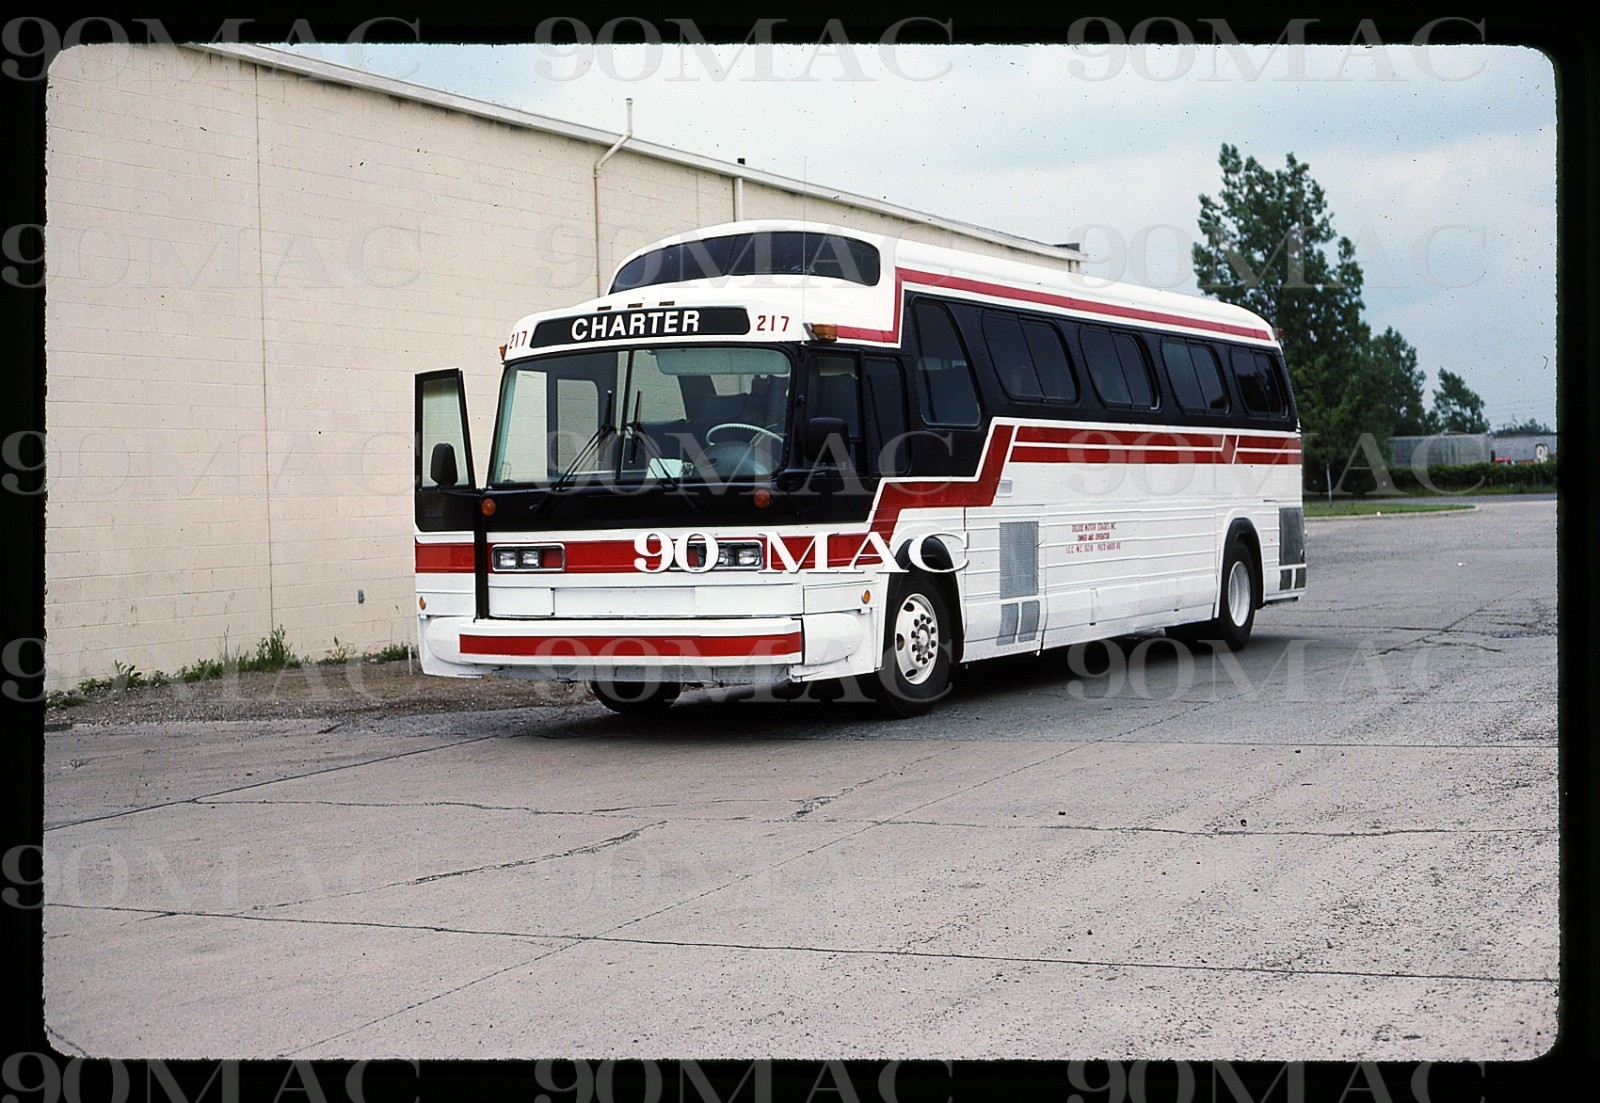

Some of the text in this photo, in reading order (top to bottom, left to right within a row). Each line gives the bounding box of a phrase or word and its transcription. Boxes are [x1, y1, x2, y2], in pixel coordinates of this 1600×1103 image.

[571, 310, 700, 341] CHARTER
[757, 315, 790, 332] 217
[508, 331, 528, 350] 217
